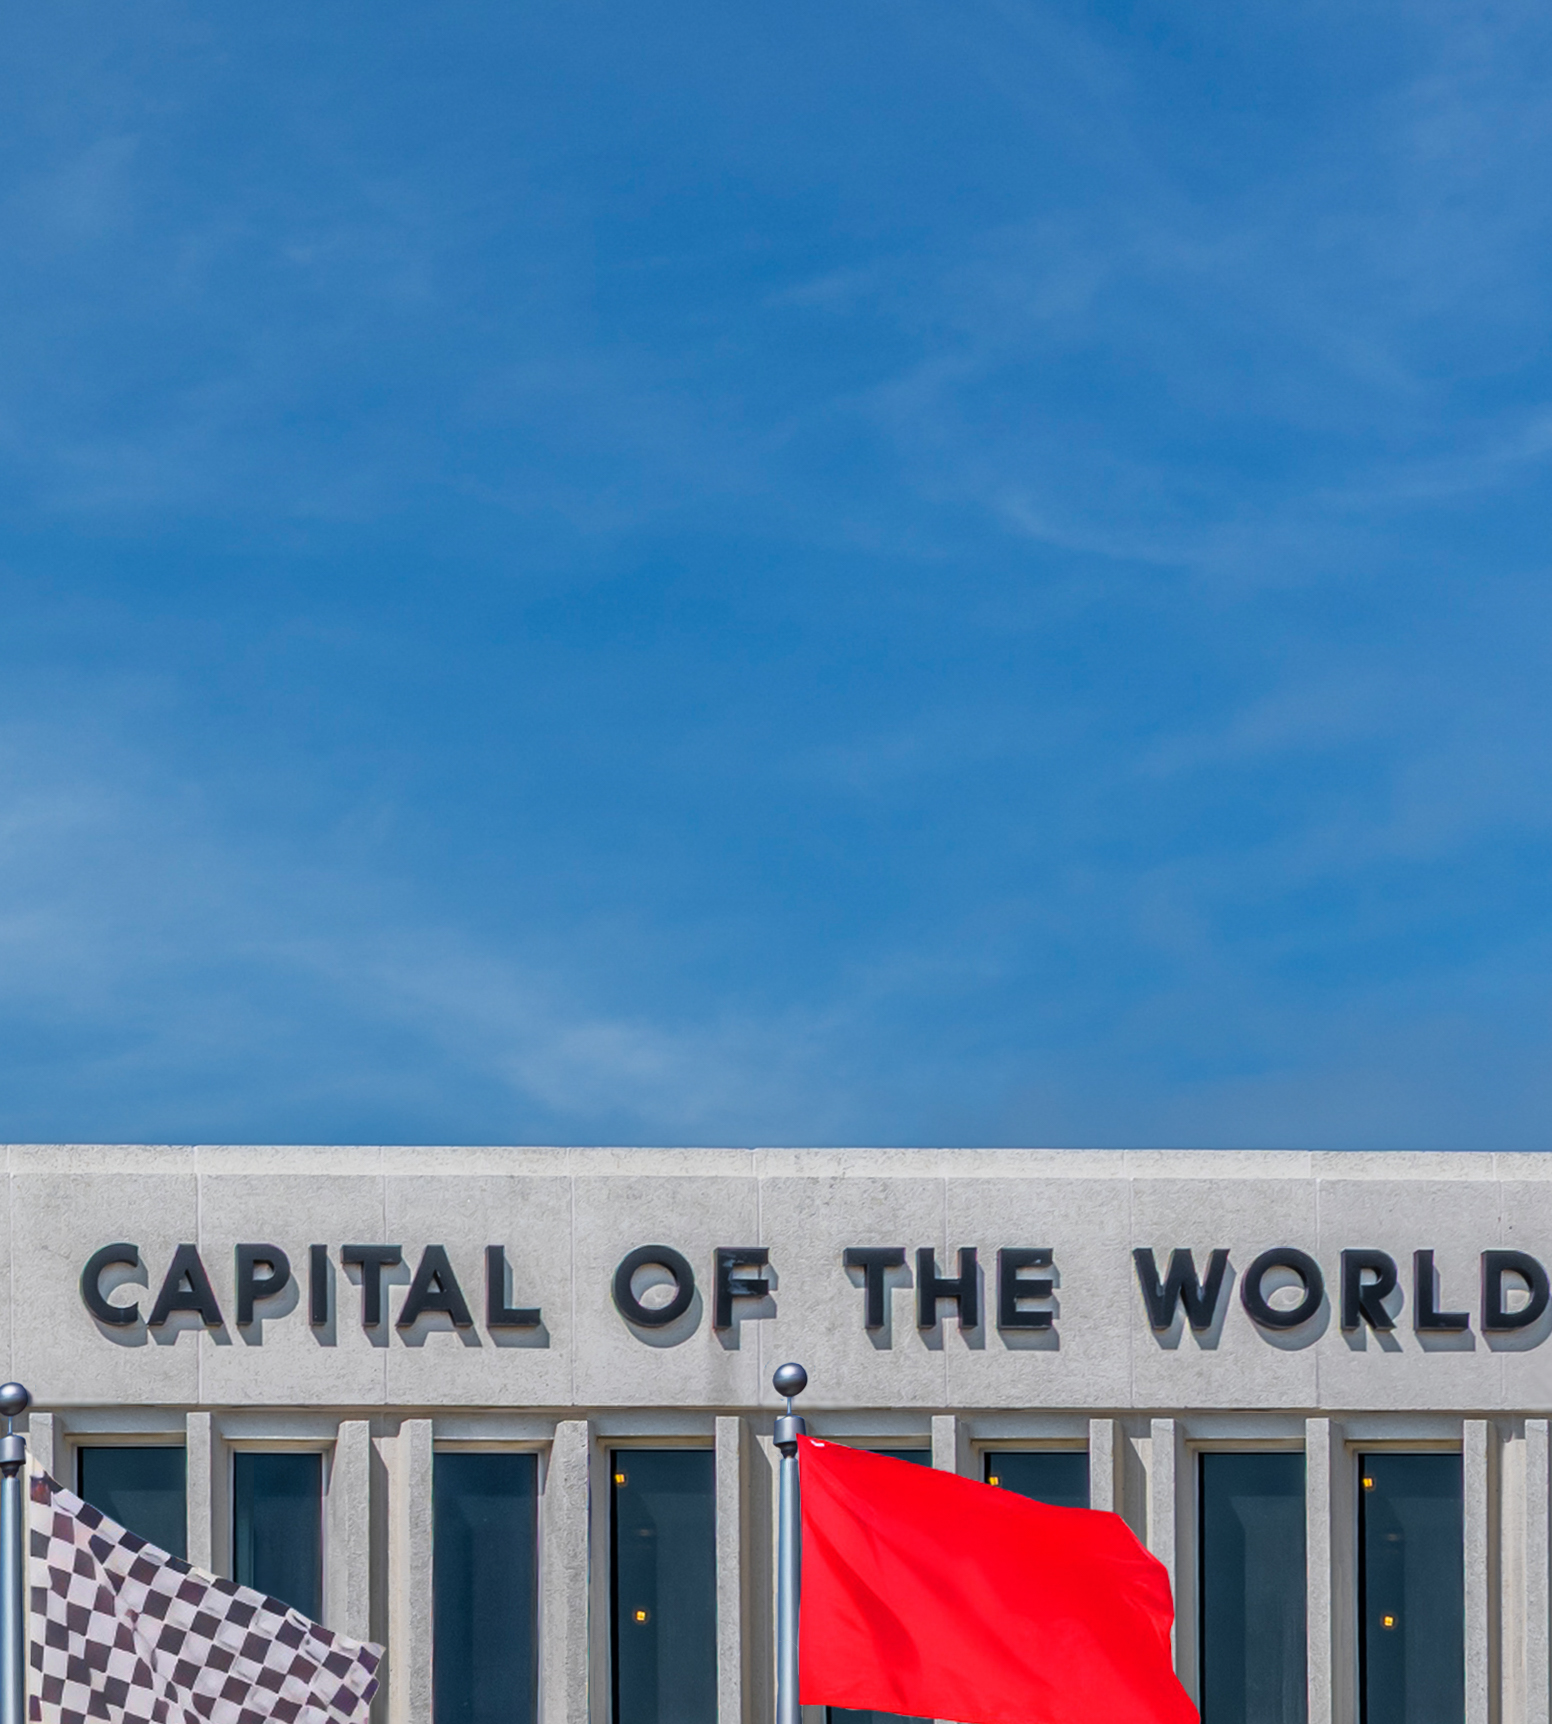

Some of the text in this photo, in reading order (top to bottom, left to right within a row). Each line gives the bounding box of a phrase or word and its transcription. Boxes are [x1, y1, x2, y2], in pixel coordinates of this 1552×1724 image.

[78, 1241, 542, 1328] CAPITAL
[610, 1244, 770, 1330] OF
[842, 1245, 1055, 1331] THE
[1131, 1245, 1552, 1332] WORLD
